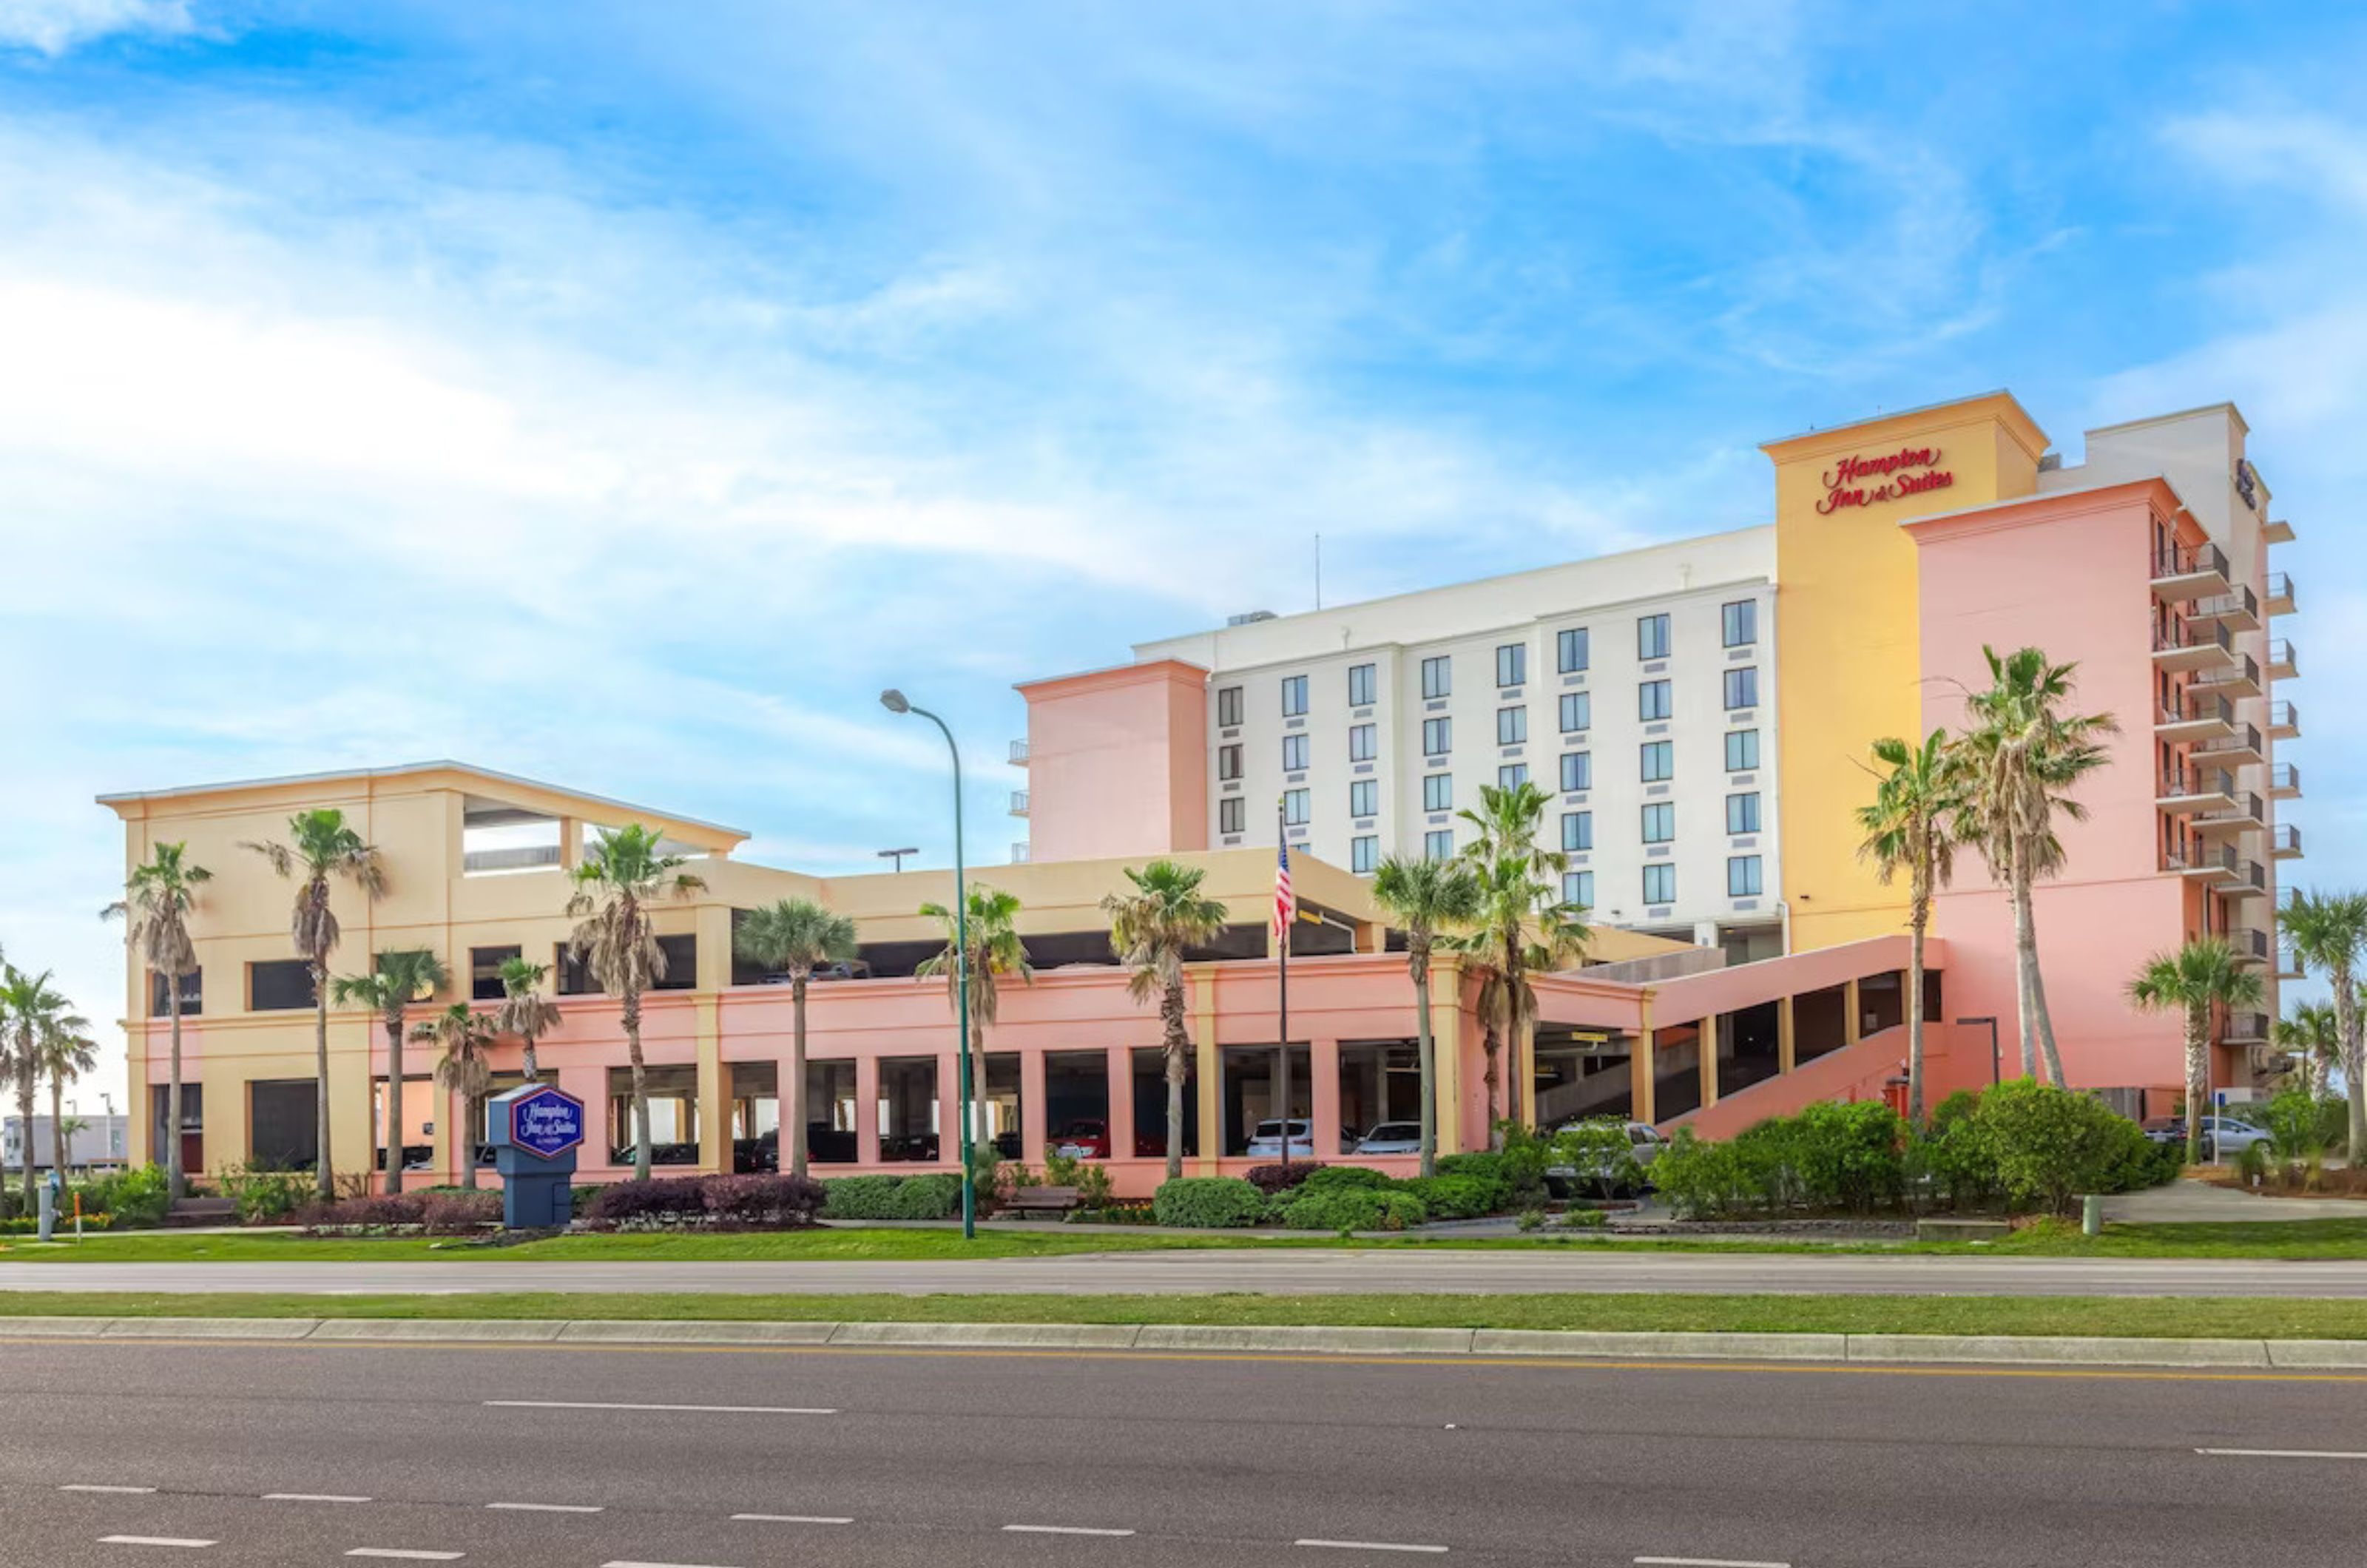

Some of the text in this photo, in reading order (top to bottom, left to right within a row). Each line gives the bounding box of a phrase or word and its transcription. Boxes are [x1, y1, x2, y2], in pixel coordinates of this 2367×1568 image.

[1823, 448, 1941, 488] Hampton
[1816, 487, 1874, 515] Inn
[1888, 470, 1953, 498] Suites
[522, 1102, 573, 1121] Hampton
[521, 1121, 544, 1136] Inn
[553, 1119, 576, 1135] Suites
